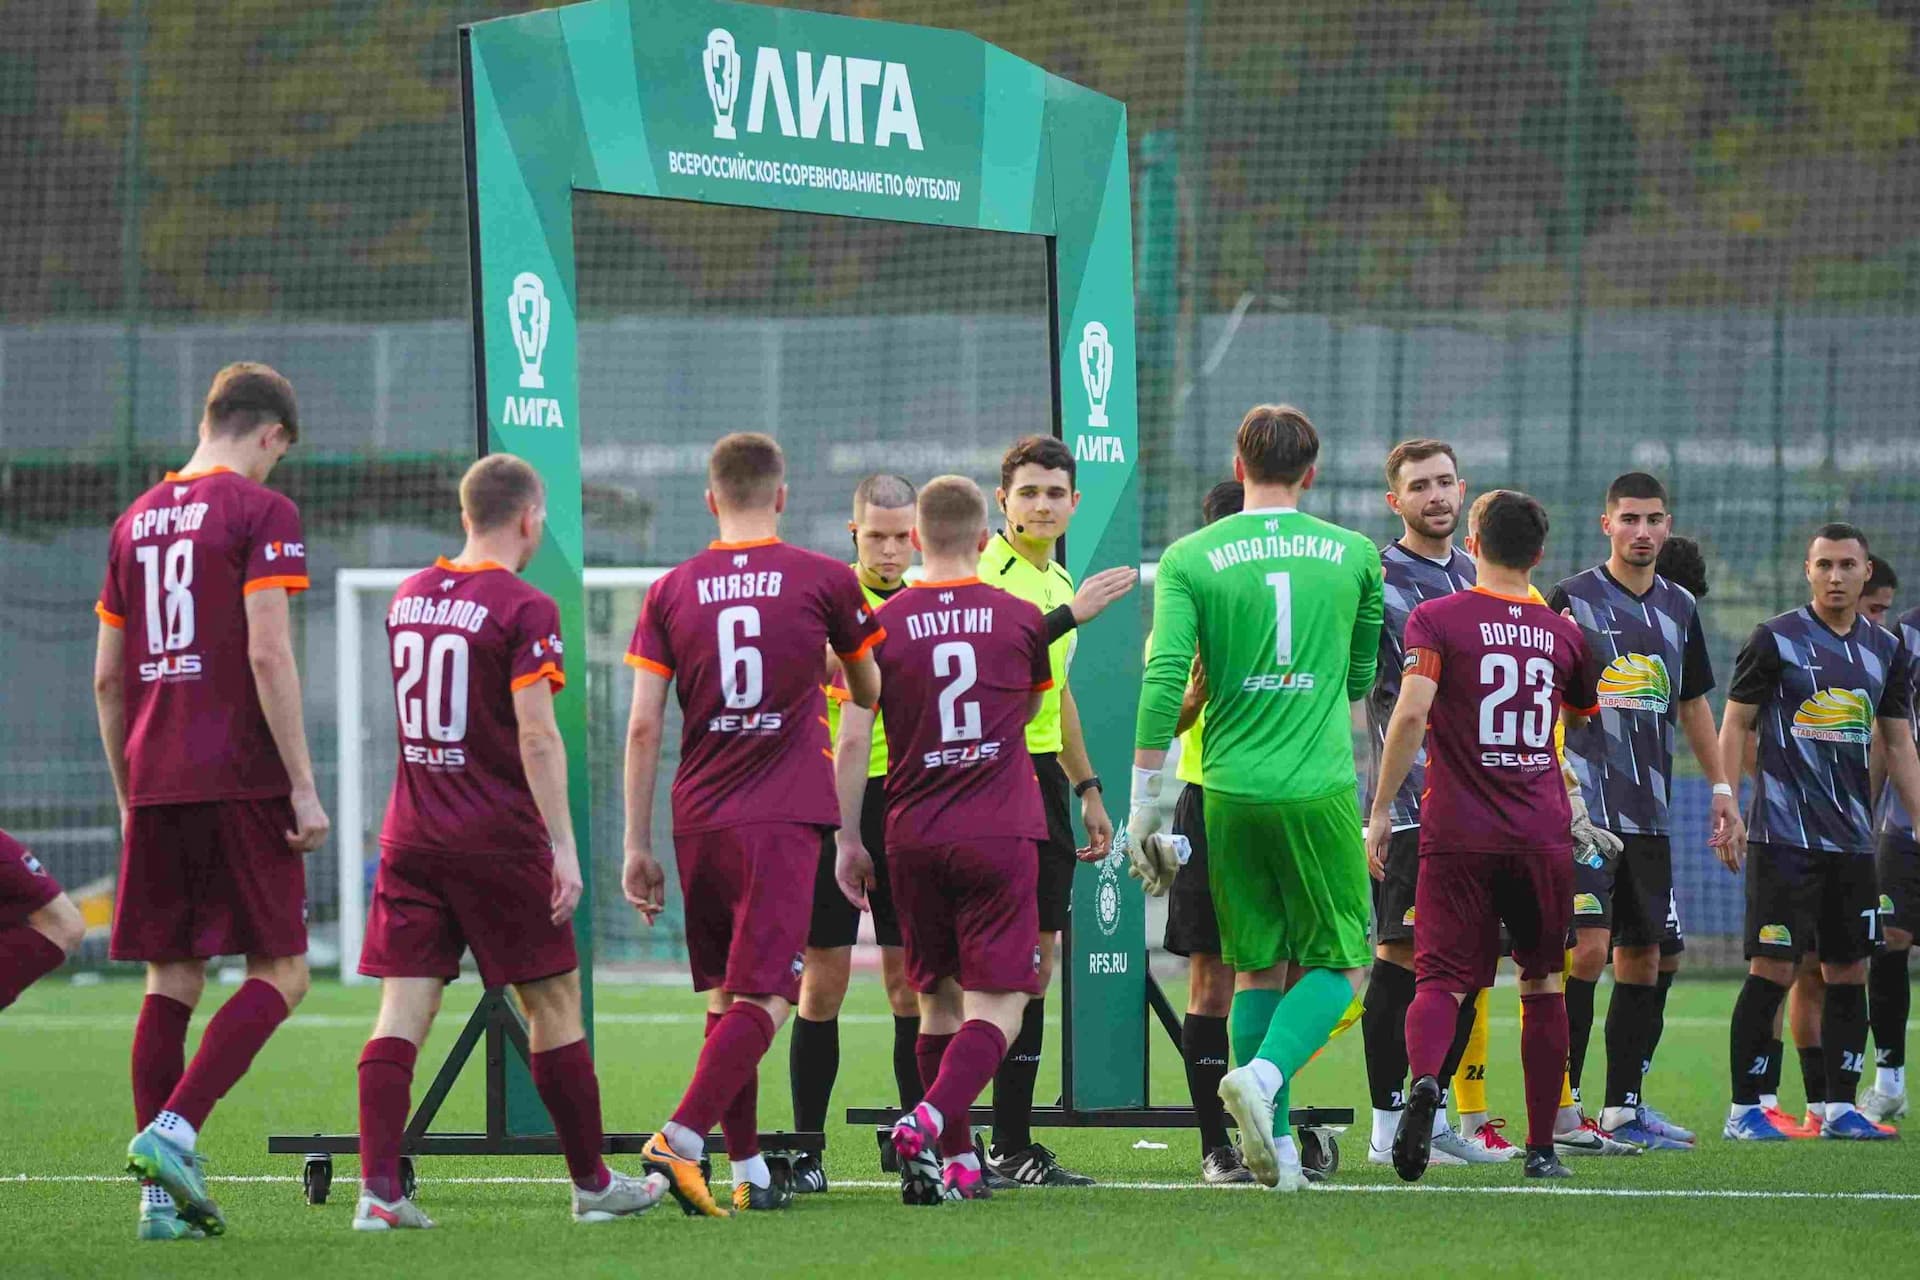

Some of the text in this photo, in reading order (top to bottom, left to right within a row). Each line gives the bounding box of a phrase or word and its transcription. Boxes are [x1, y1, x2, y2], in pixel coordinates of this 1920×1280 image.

[747, 46, 924, 151] ЛИГА
[668, 150, 961, 201] ВСЕРОССИЙСКОЕ СОРЕВНОВАНИЕ ПО ФУТБОЛУ
[502, 395, 564, 428] ЛИГА
[1075, 434, 1125, 463] ЛИГА
[1207, 535, 1346, 572] МАСАЛЬСКИХ
[136, 539, 195, 655] 18
[697, 571, 782, 604] КНЯЗЕВ
[906, 608, 993, 640] ПЛУГИН
[1265, 571, 1292, 666] 1
[1479, 622, 1554, 655] ВОРОНА
[139, 654, 202, 682] SUS
[717, 605, 763, 709] 6
[393, 631, 468, 742] 20
[933, 641, 982, 742] 2
[1242, 672, 1314, 691] SEUS
[1479, 652, 1555, 748] 23
[403, 744, 466, 766] SEUS
[923, 742, 1001, 768] SEUS
[1481, 751, 1551, 766] SEUS
[1089, 952, 1128, 974] RFS.RU
